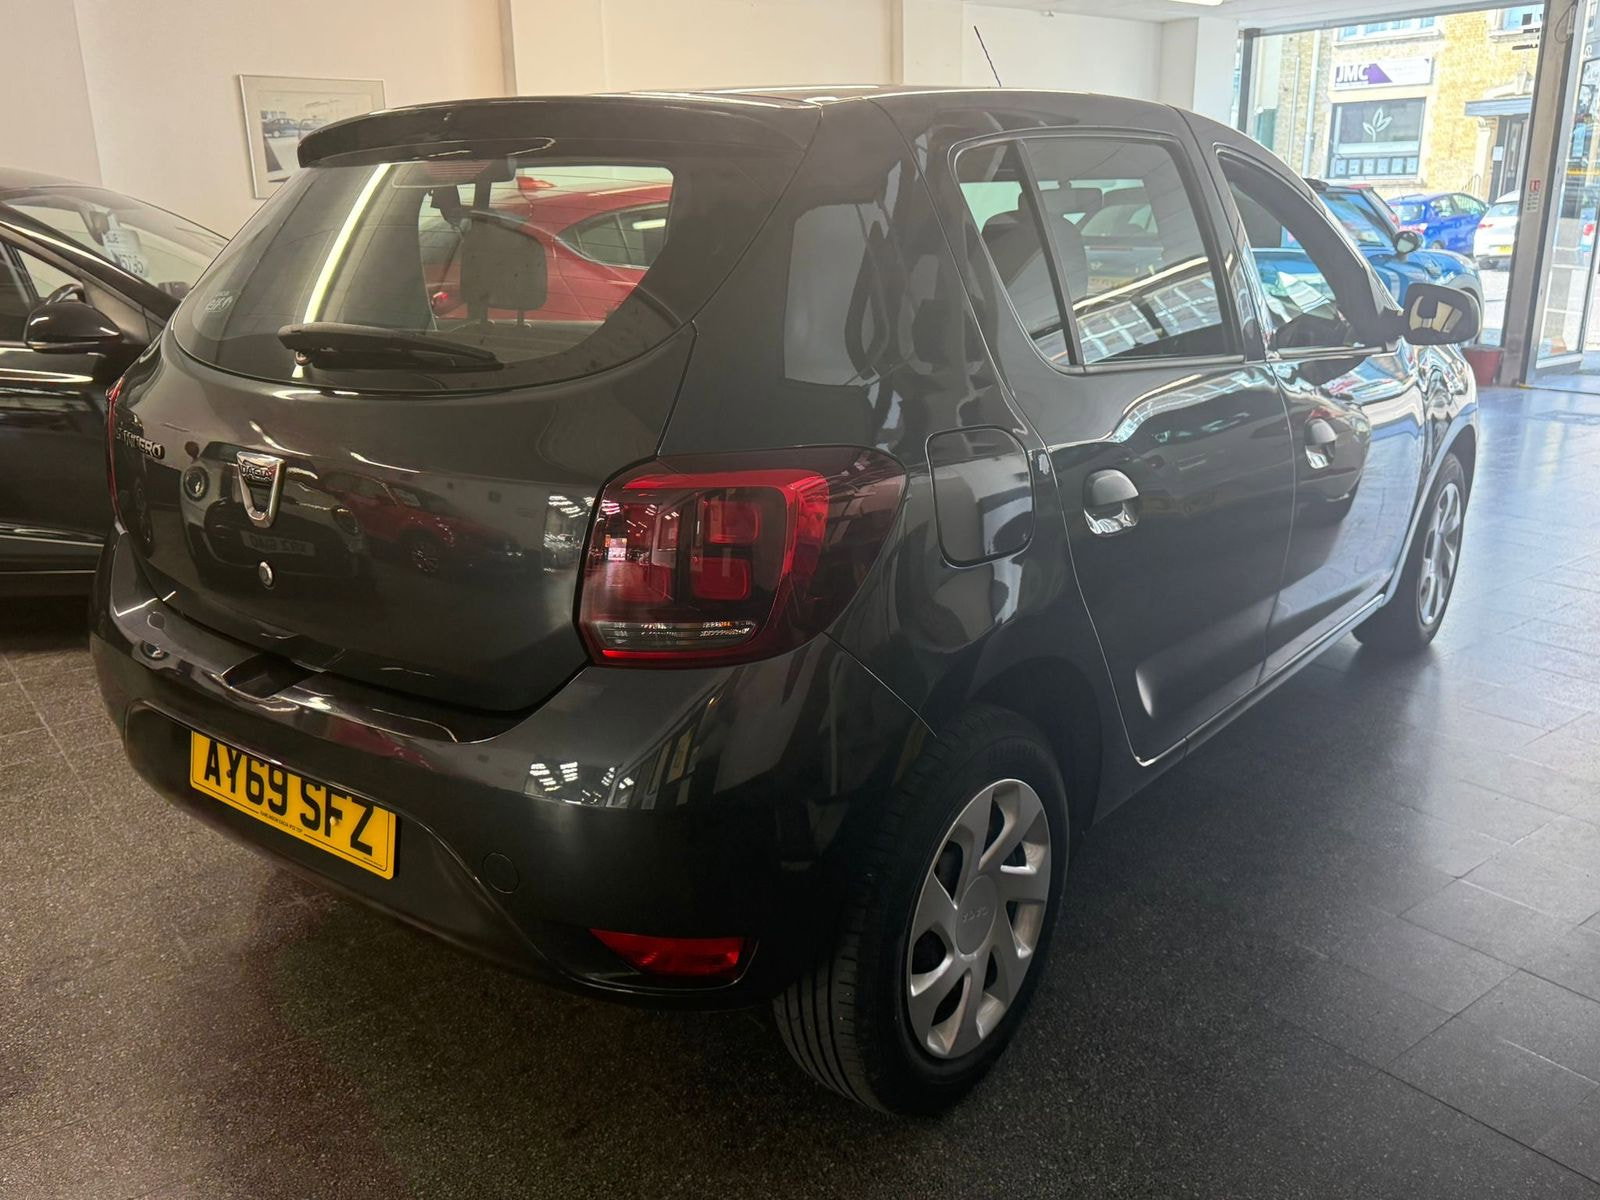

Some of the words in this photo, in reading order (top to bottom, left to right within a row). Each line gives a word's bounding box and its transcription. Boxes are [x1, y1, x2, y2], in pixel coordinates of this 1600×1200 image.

[1336, 63, 1369, 83] JMC
[203, 739, 289, 817] AY69
[300, 777, 374, 857] SFZ
